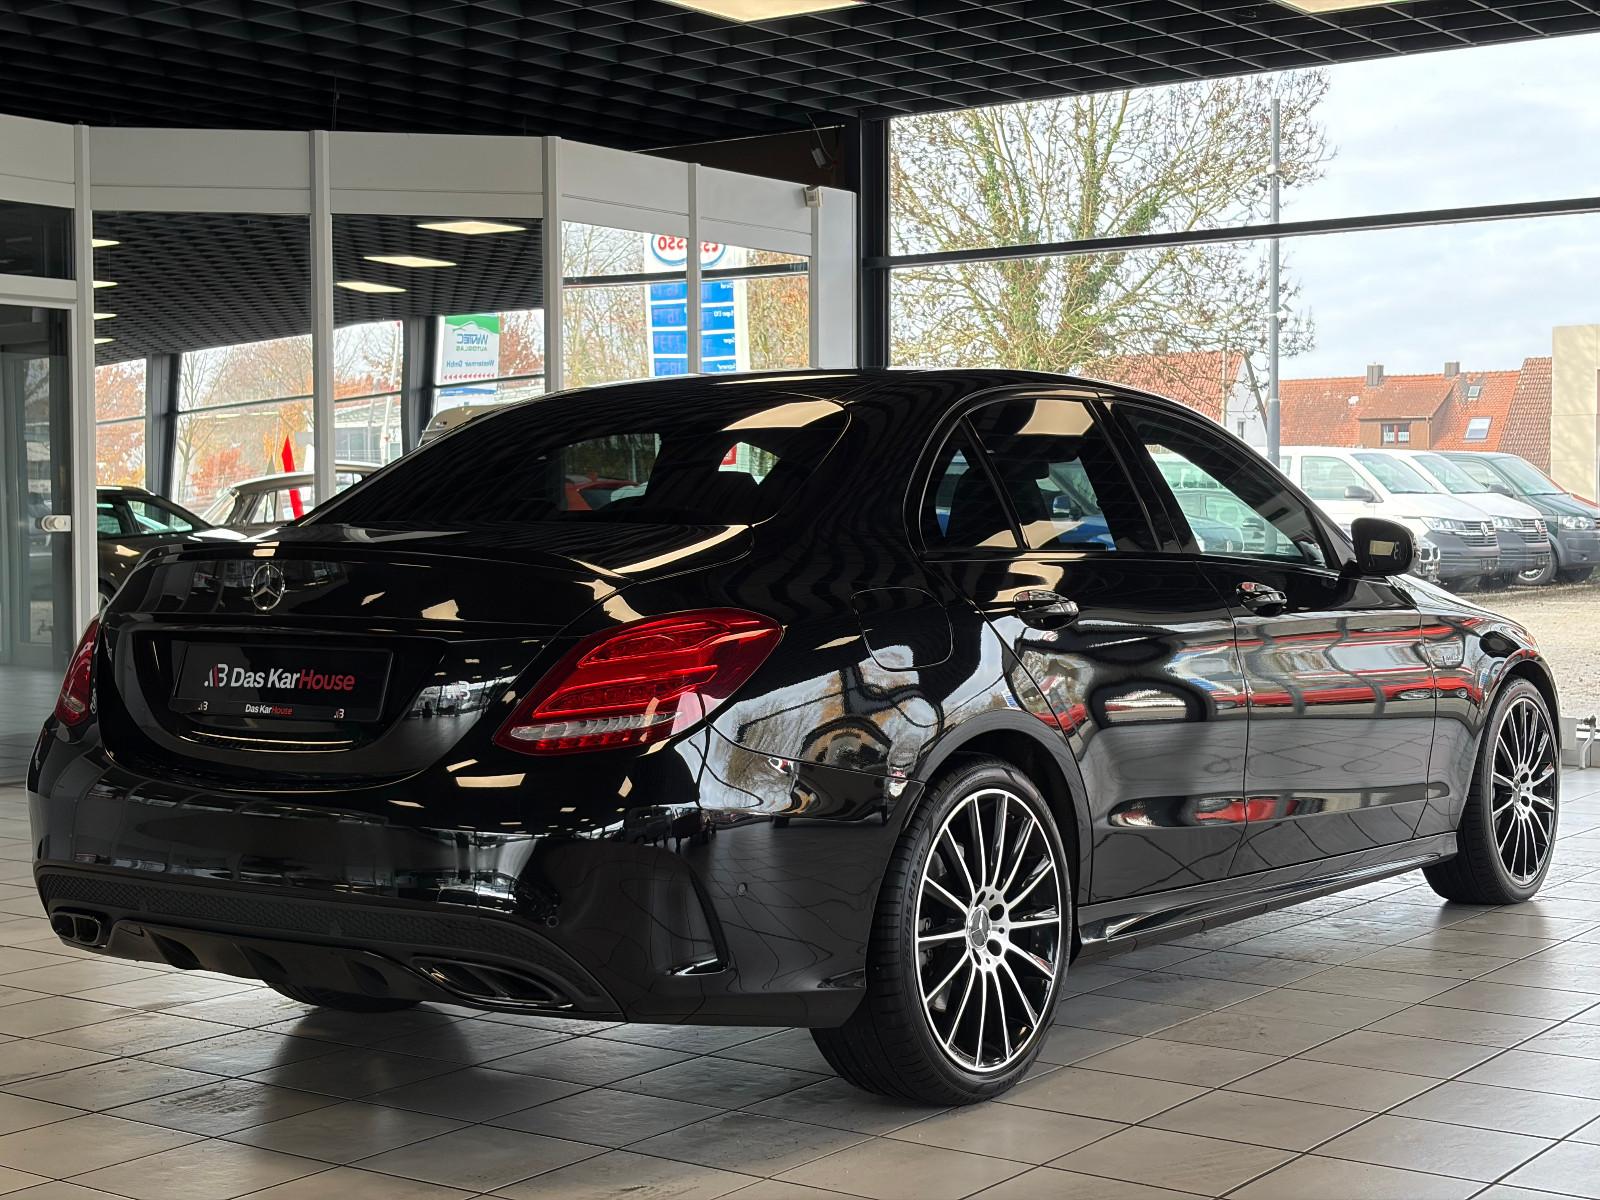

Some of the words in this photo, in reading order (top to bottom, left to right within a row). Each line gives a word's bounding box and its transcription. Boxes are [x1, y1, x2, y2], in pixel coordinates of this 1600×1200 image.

[230, 667, 266, 688] Das
[267, 668, 356, 691] KarHouse
[245, 703, 260, 713] Das
